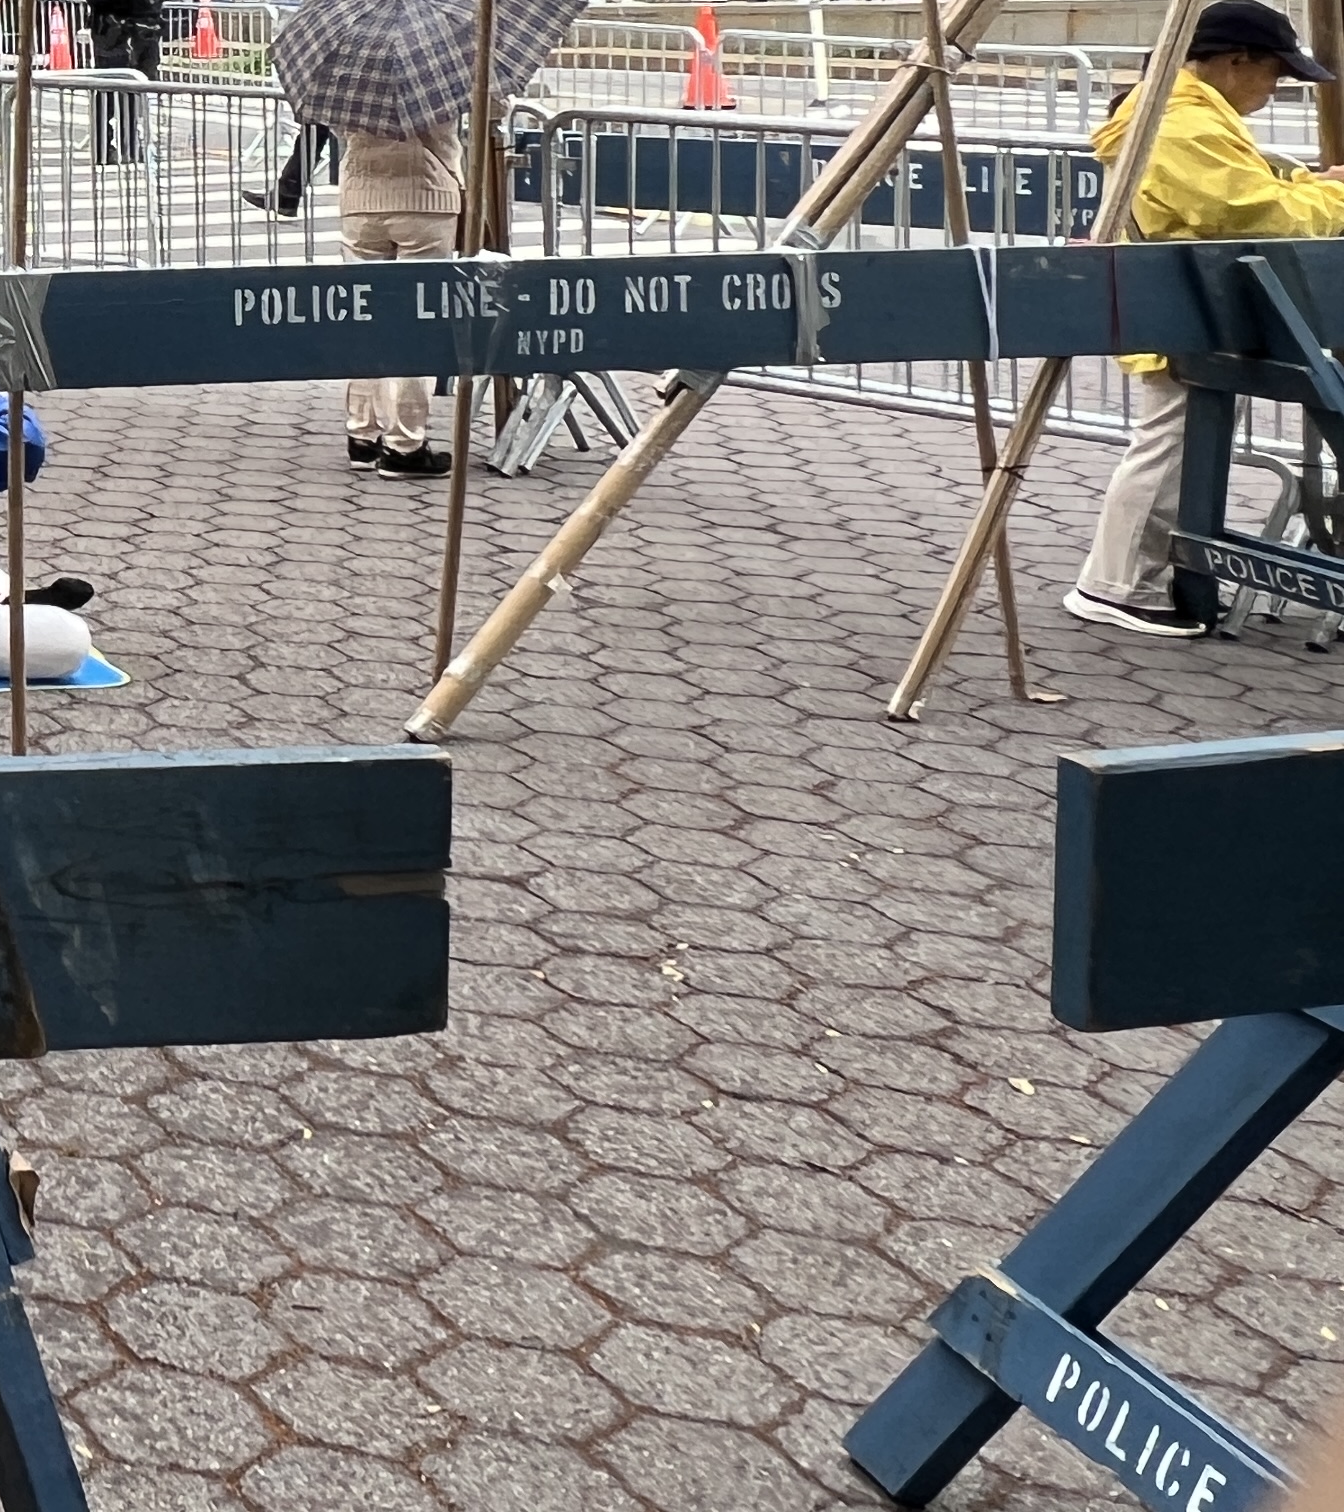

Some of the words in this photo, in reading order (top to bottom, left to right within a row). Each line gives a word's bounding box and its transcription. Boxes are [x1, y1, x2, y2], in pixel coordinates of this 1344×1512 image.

[962, 165, 1032, 196] LIE
[234, 284, 373, 326] POLICE
[417, 280, 500, 319] LINE
[550, 278, 596, 315] DO
[625, 275, 692, 313] NOT
[722, 272, 842, 310] CROS
[517, 329, 585, 355] NYPD
[1204, 547, 1321, 601] POLICE
[1045, 1352, 1227, 1512] POLICE
